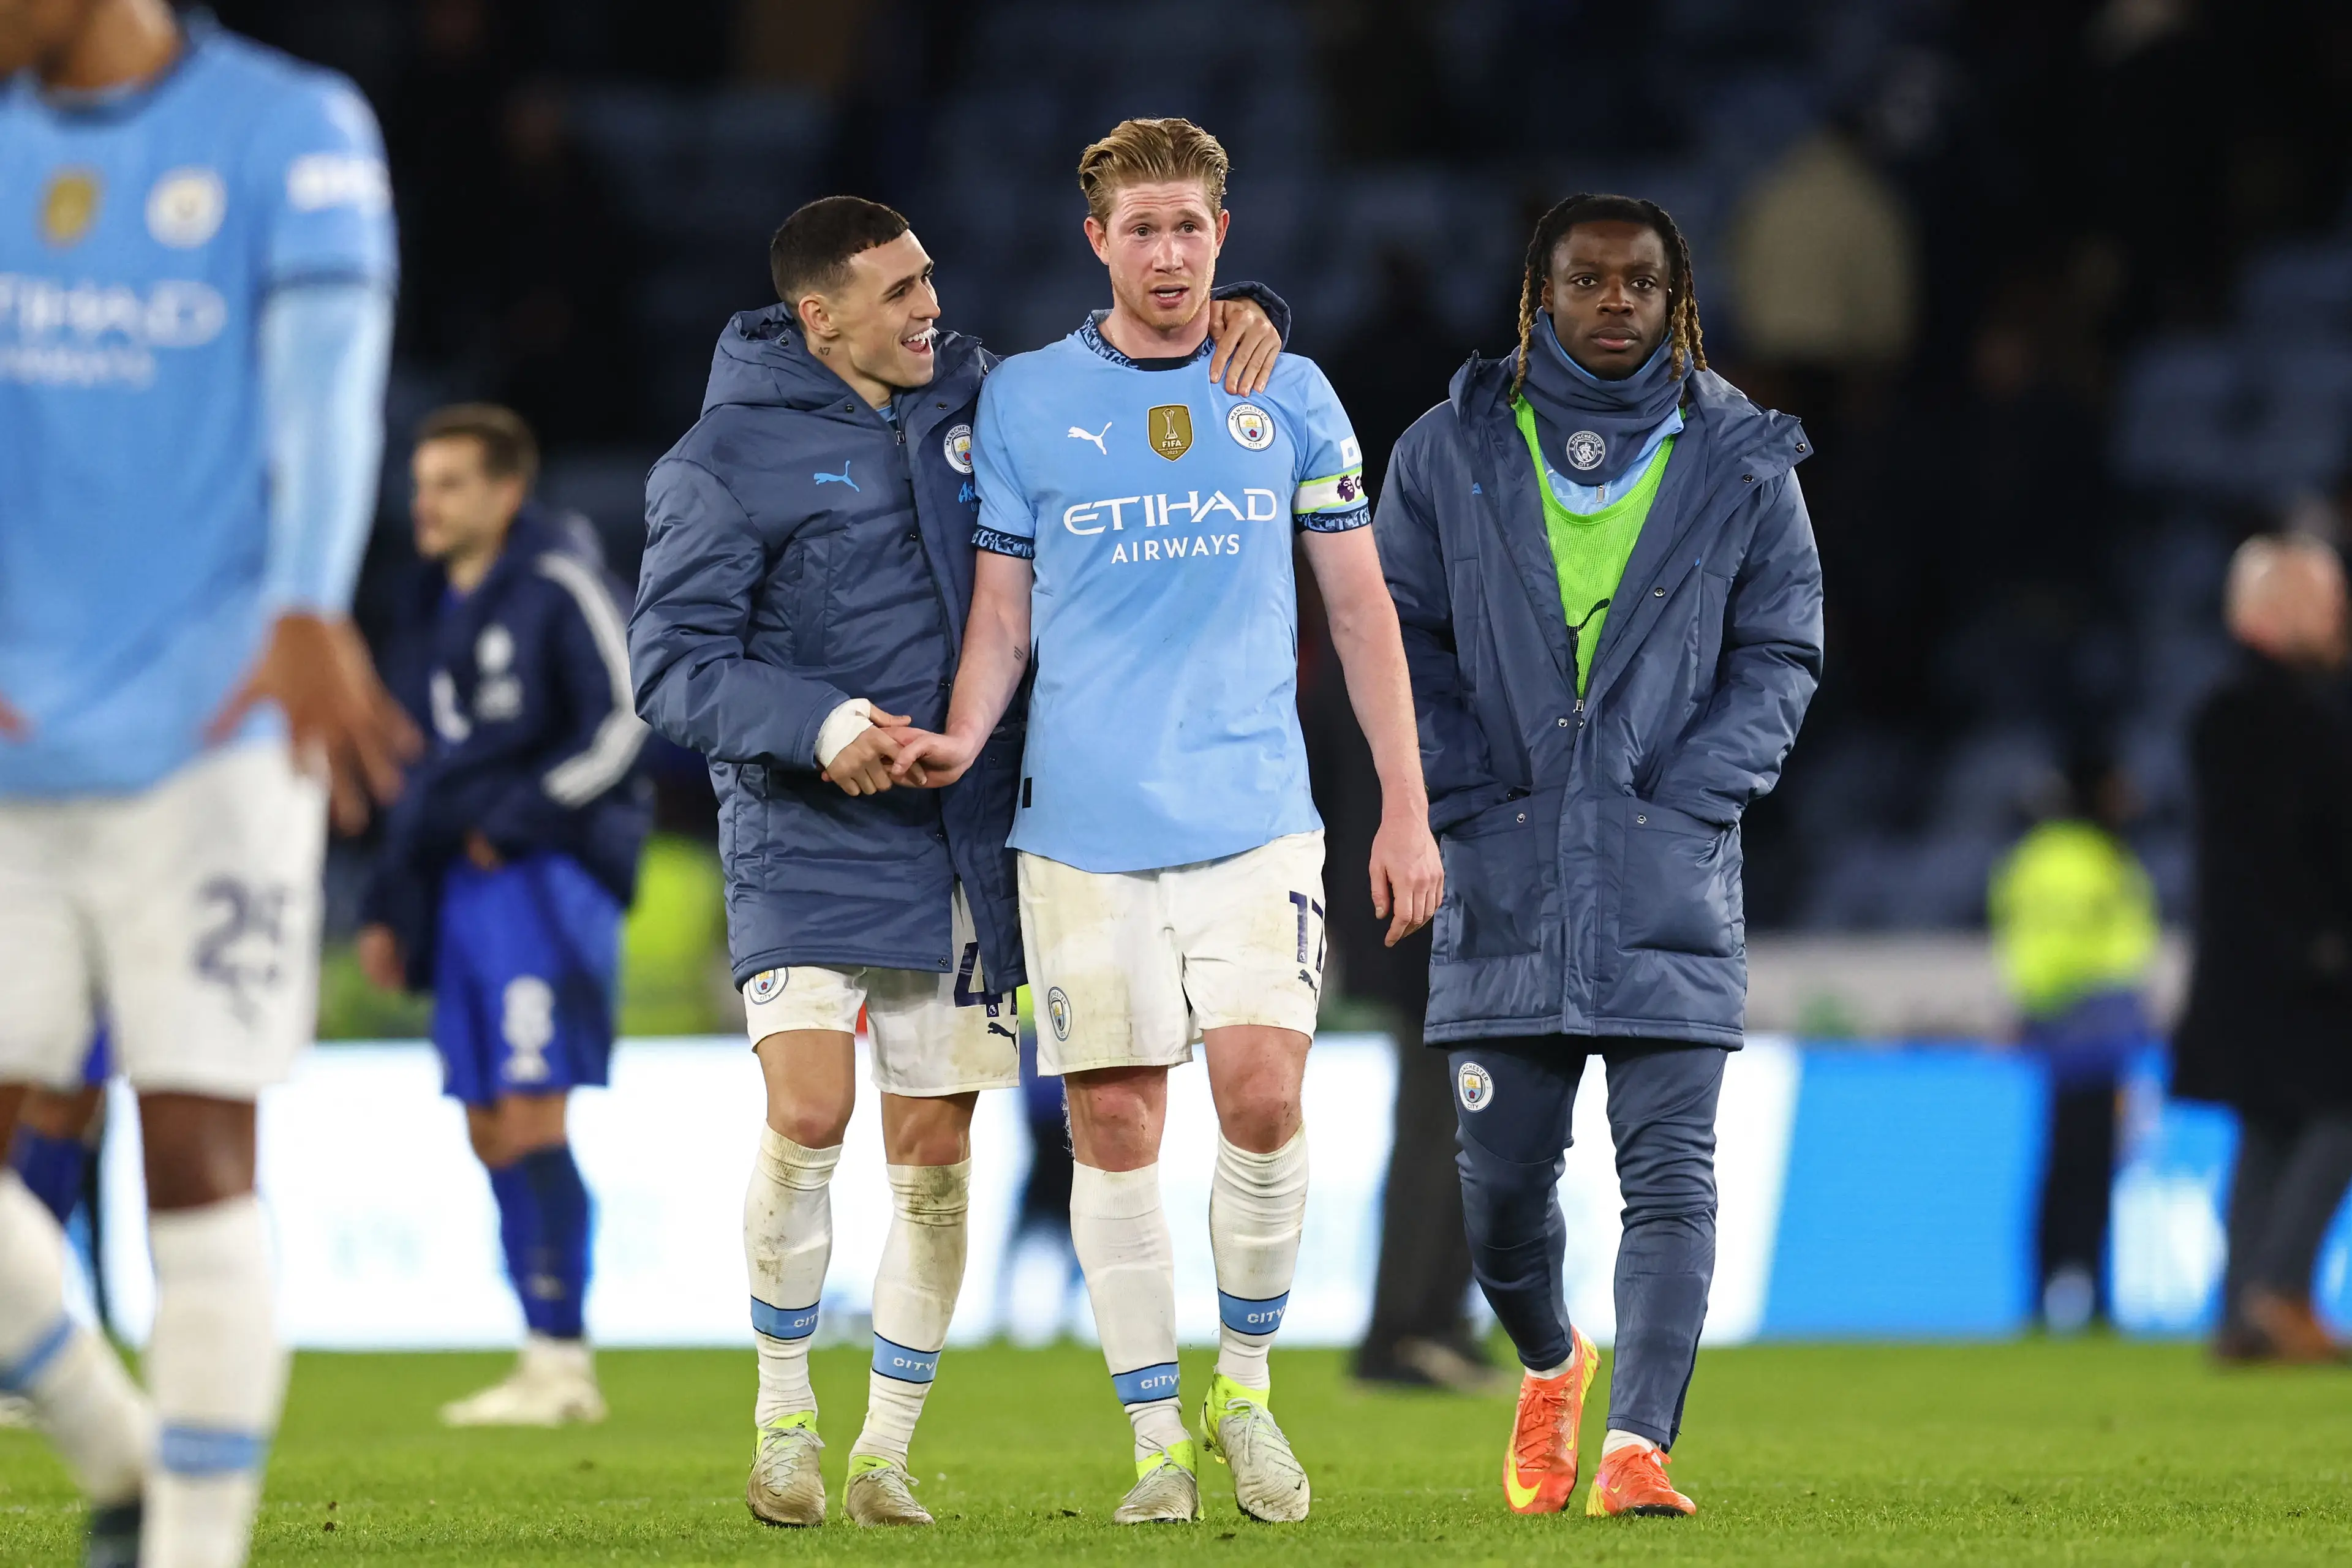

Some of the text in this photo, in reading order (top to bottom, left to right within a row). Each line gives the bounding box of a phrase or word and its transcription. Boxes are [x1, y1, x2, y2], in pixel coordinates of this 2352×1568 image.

[818, 347, 831, 356] 47
[1231, 405, 1268, 421] MANCHESTER
[946, 426, 971, 446] MANCHEST
[1571, 434, 1601, 447] MANCHESTER
[1063, 488, 1277, 535] ETIHAD
[1111, 533, 1240, 564] AIRWAYS
[1460, 1064, 1489, 1082] MANCHESTER
[1247, 1304, 1286, 1324] CITY
[893, 1357, 935, 1371] CITY
[1140, 1373, 1180, 1390] CITY
